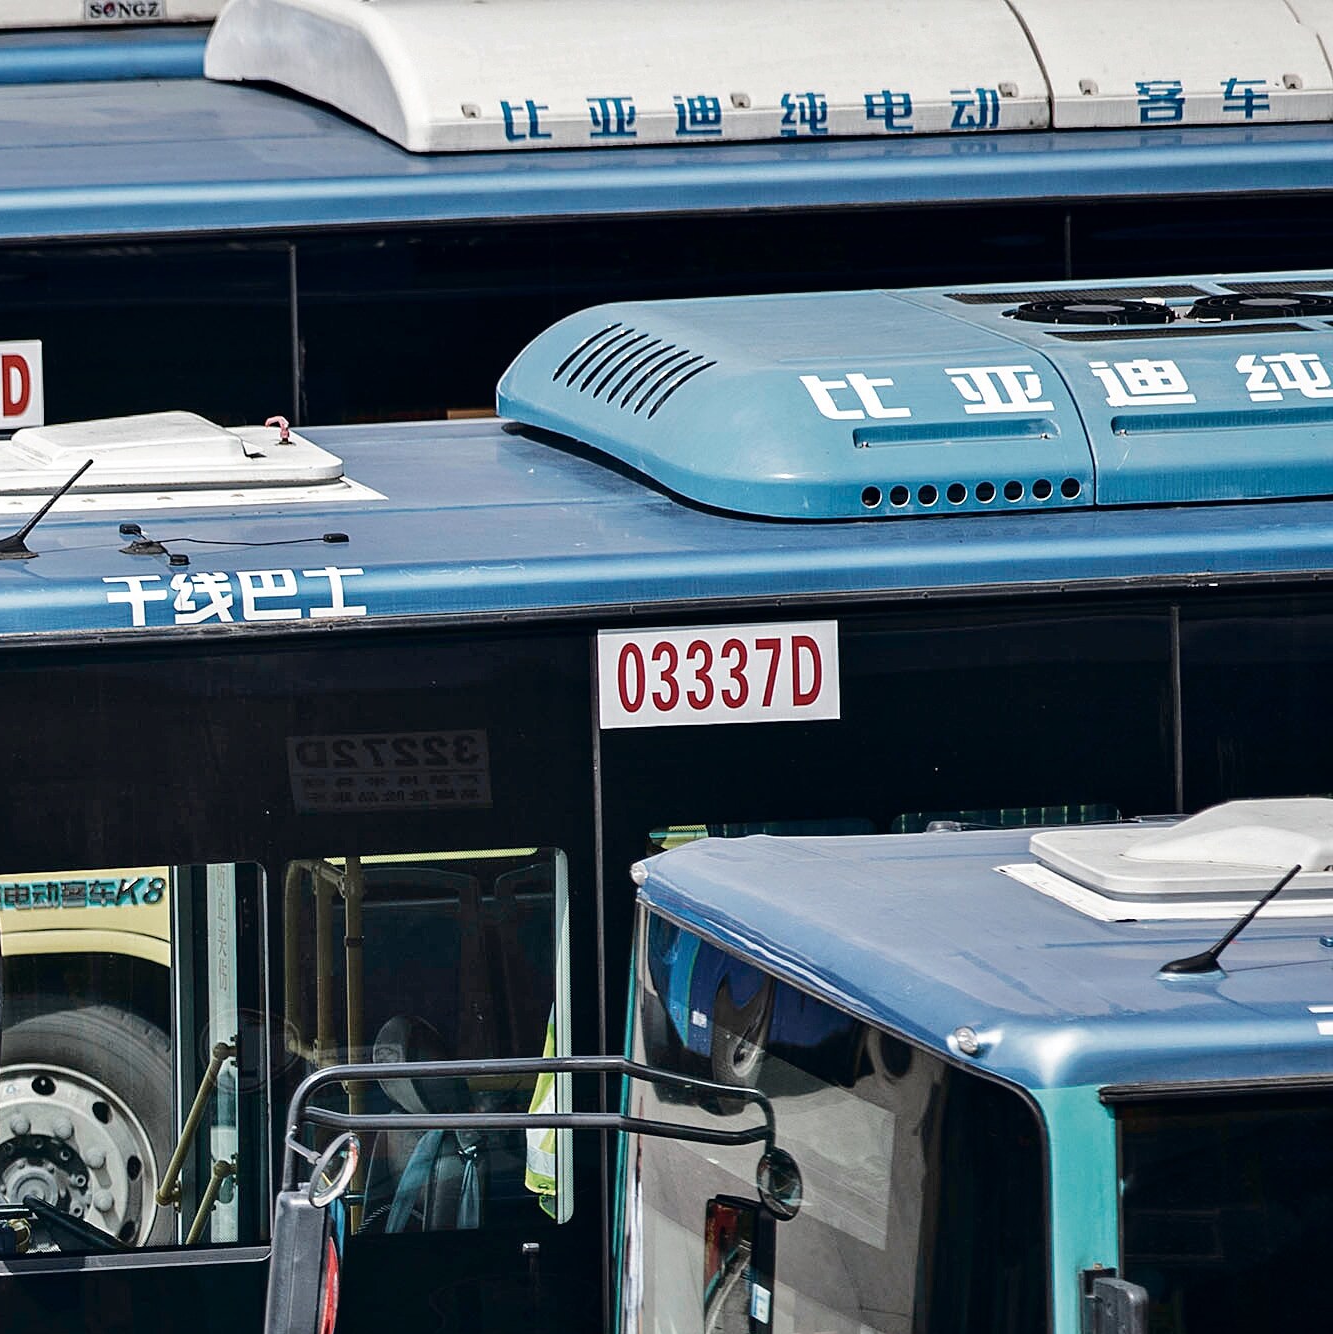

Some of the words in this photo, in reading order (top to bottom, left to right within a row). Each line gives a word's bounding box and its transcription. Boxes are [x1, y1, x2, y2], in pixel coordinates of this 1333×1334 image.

[89, 2, 160, 18] SONGZ
[102, 566, 367, 626] 干线巴士
[617, 635, 823, 713] 03337D
